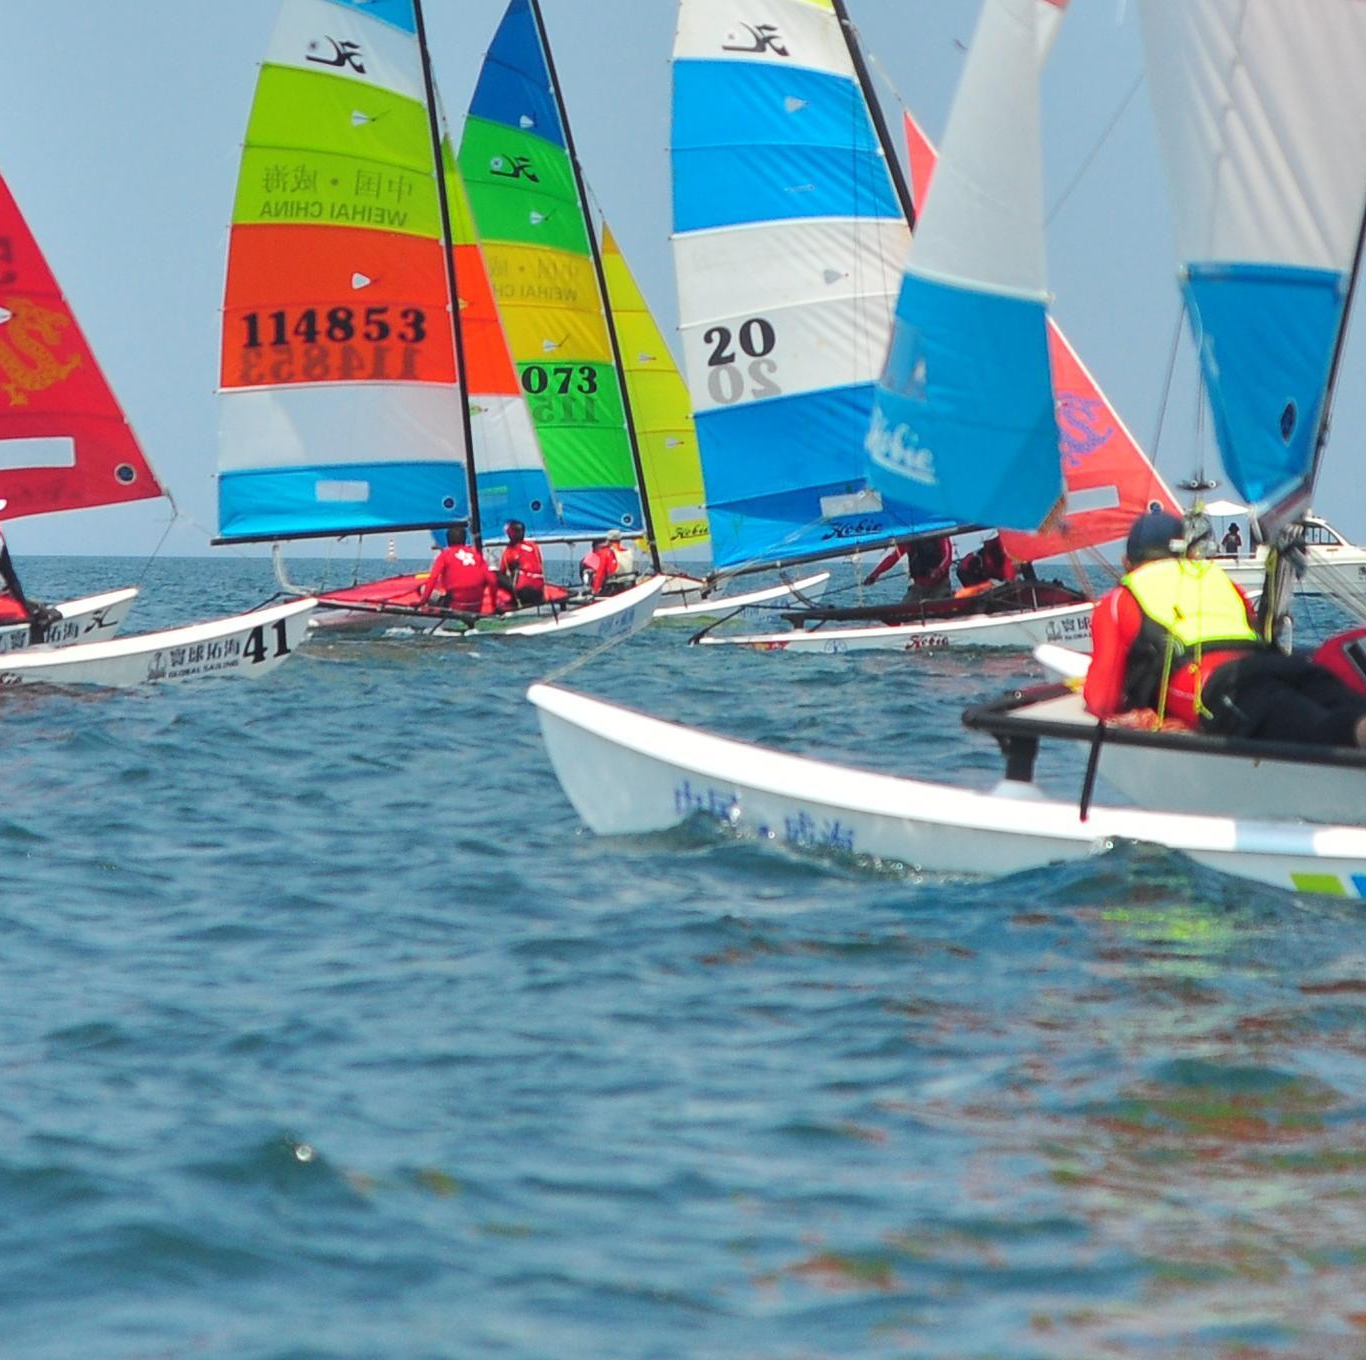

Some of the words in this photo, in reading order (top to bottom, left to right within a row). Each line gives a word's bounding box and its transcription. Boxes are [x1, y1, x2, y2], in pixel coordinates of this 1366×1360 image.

[242, 306, 427, 349] 114853
[703, 317, 776, 367] 20
[521, 366, 598, 394] 073
[822, 520, 883, 541] Hobie
[243, 618, 292, 664] 41
